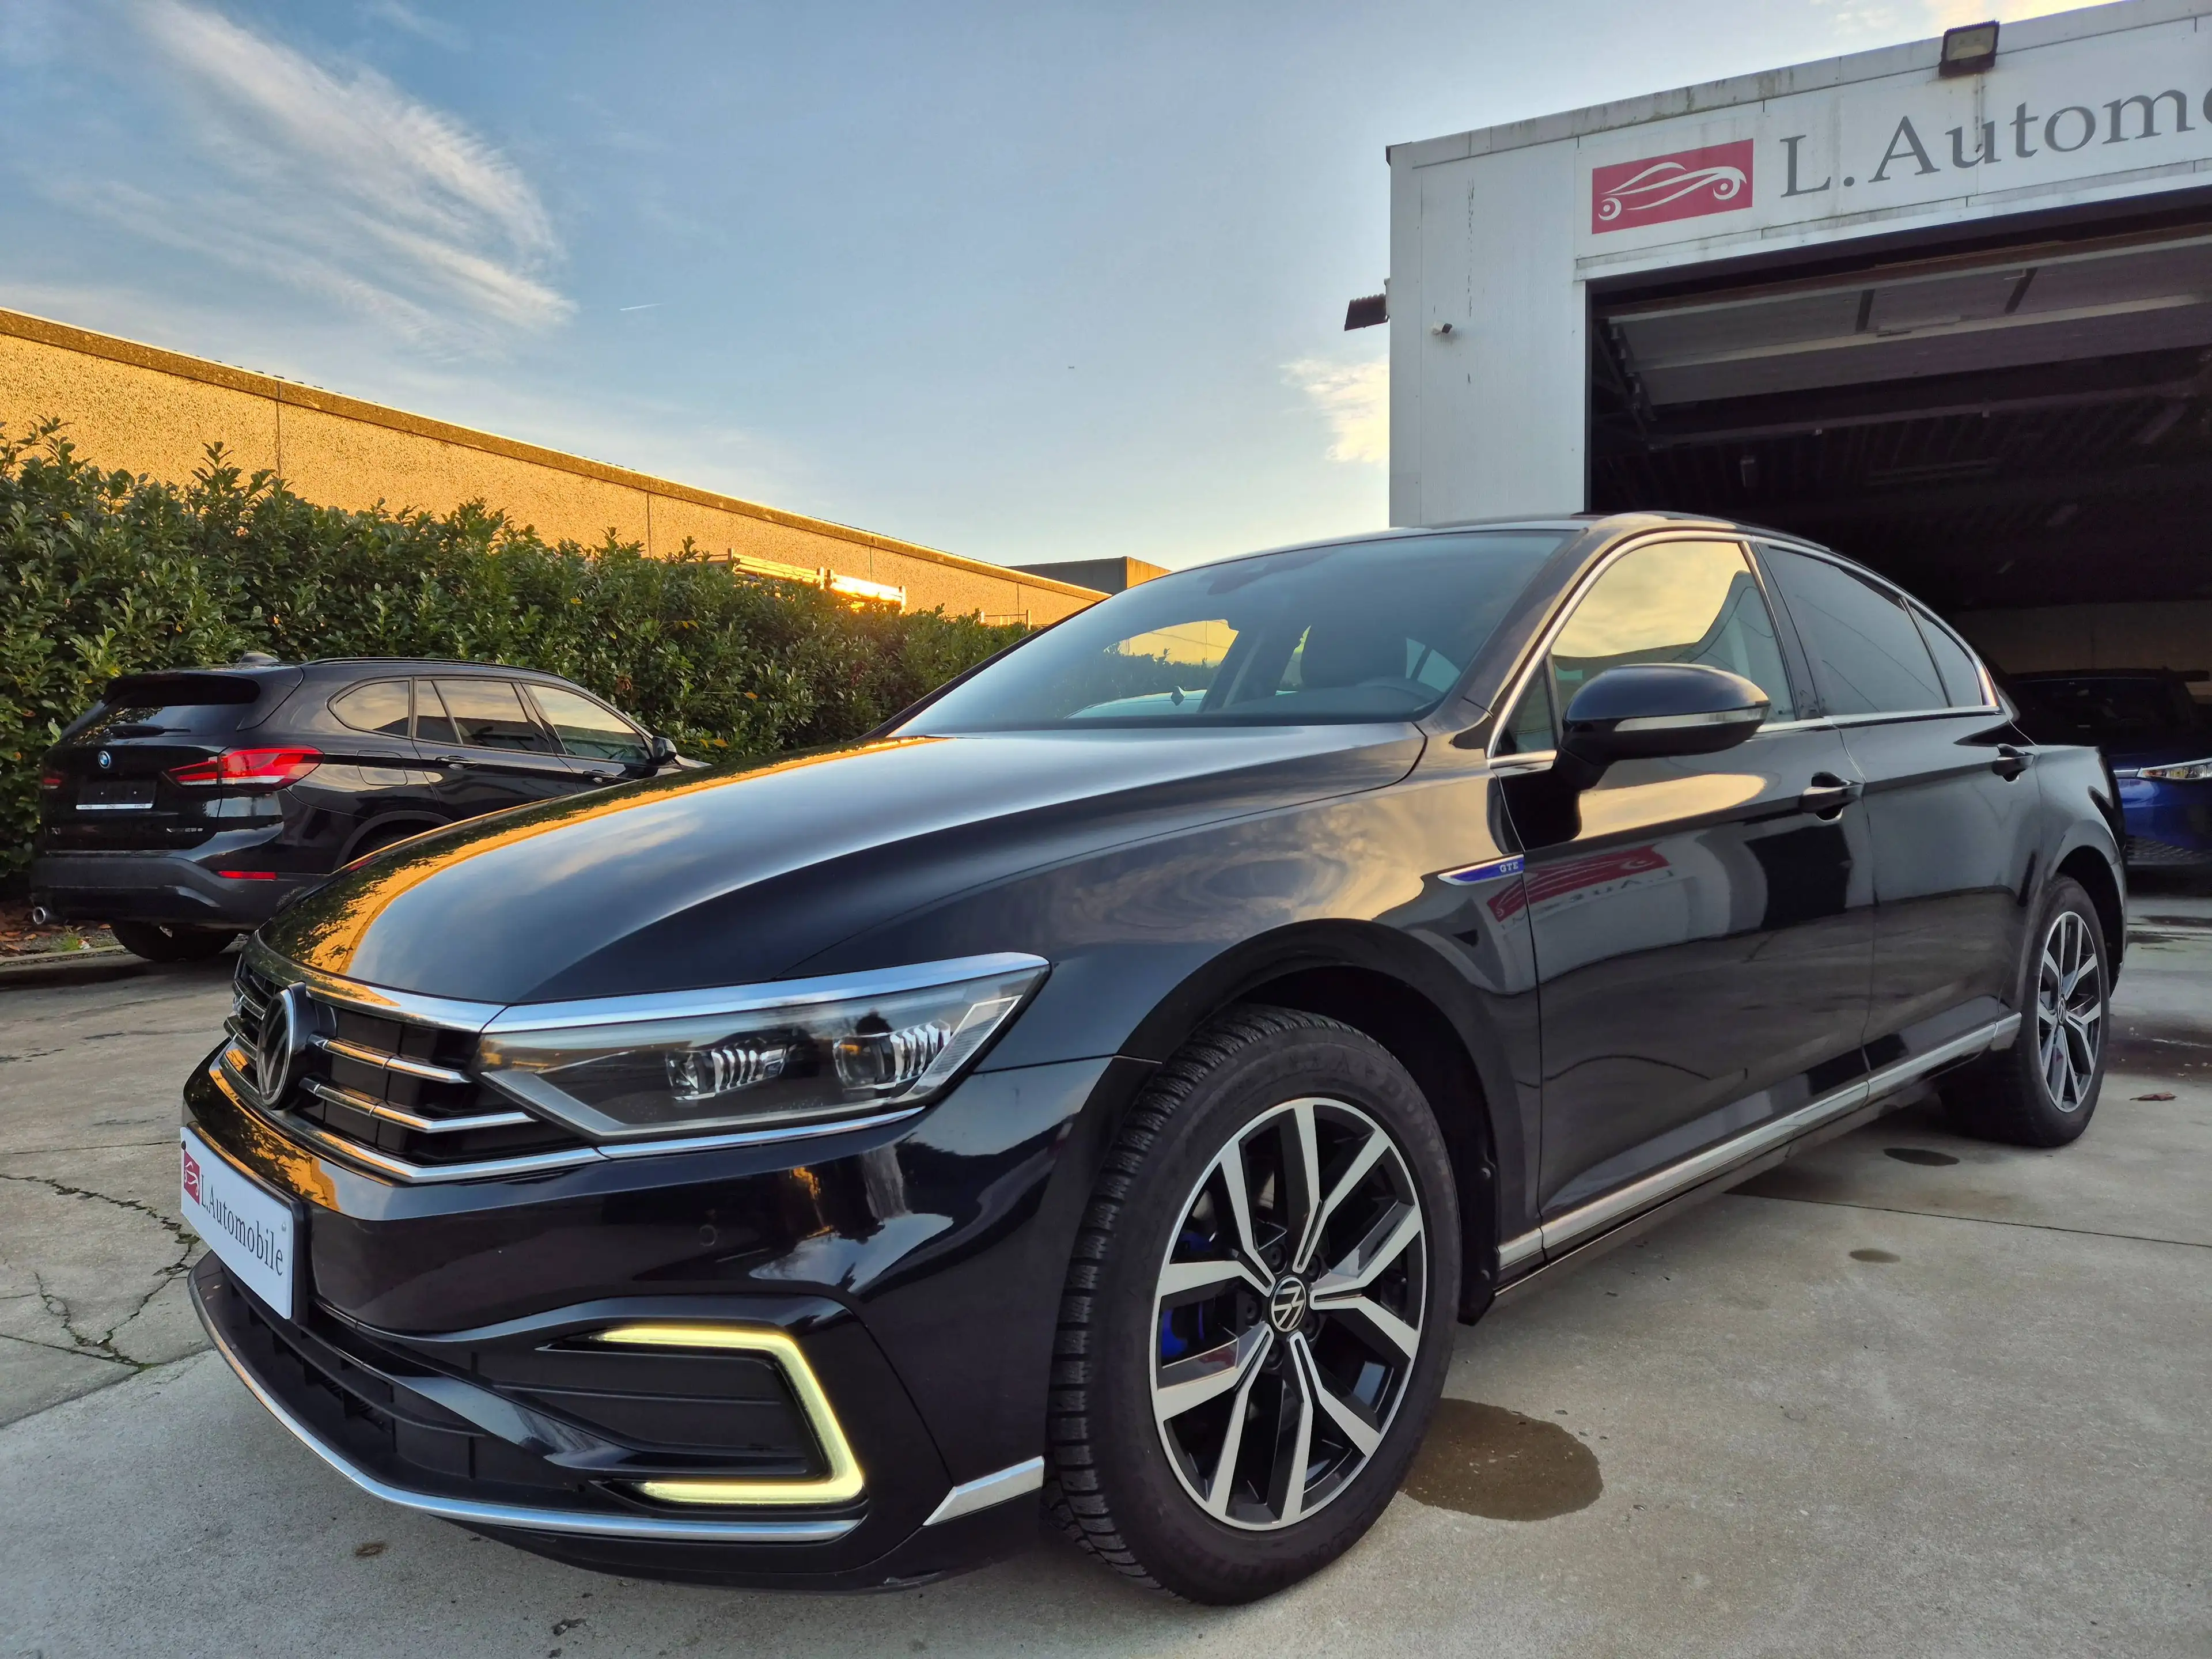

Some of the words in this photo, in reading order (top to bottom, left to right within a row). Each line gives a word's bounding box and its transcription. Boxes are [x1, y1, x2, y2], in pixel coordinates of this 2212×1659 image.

[1780, 89, 2212, 198] L.Autom
[1499, 861, 1519, 873] GTE
[201, 1173, 284, 1277] L.Automobile
